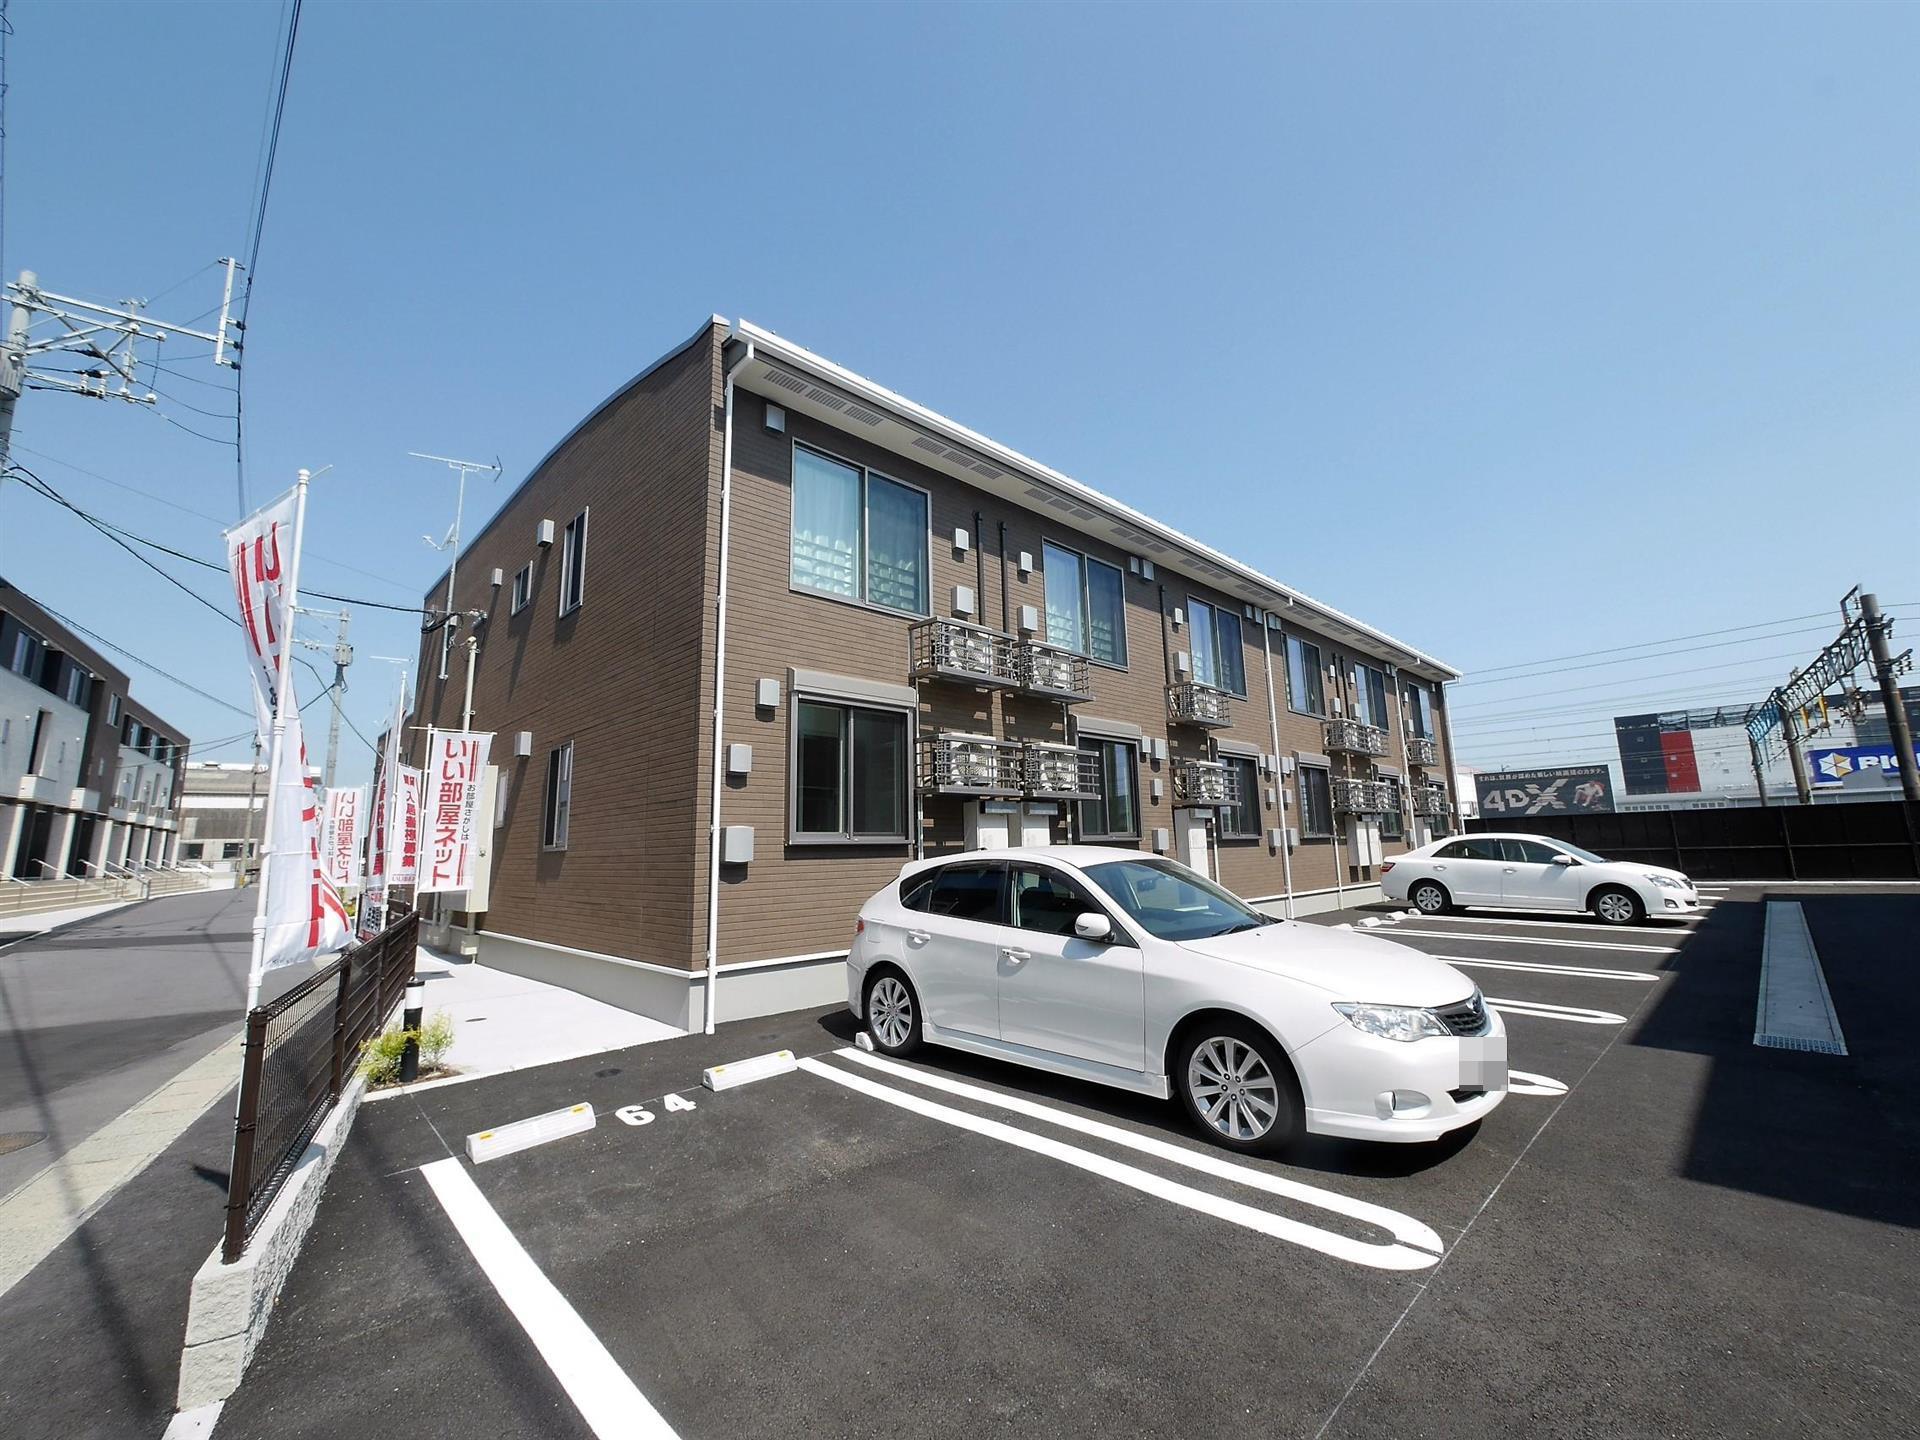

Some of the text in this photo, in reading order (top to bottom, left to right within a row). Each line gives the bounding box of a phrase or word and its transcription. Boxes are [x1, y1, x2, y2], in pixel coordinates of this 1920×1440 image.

[432, 738, 467, 887] いい部屋ネット
[460, 784, 476, 841] お部屋さがしは
[1483, 779, 1568, 815] 4DX
